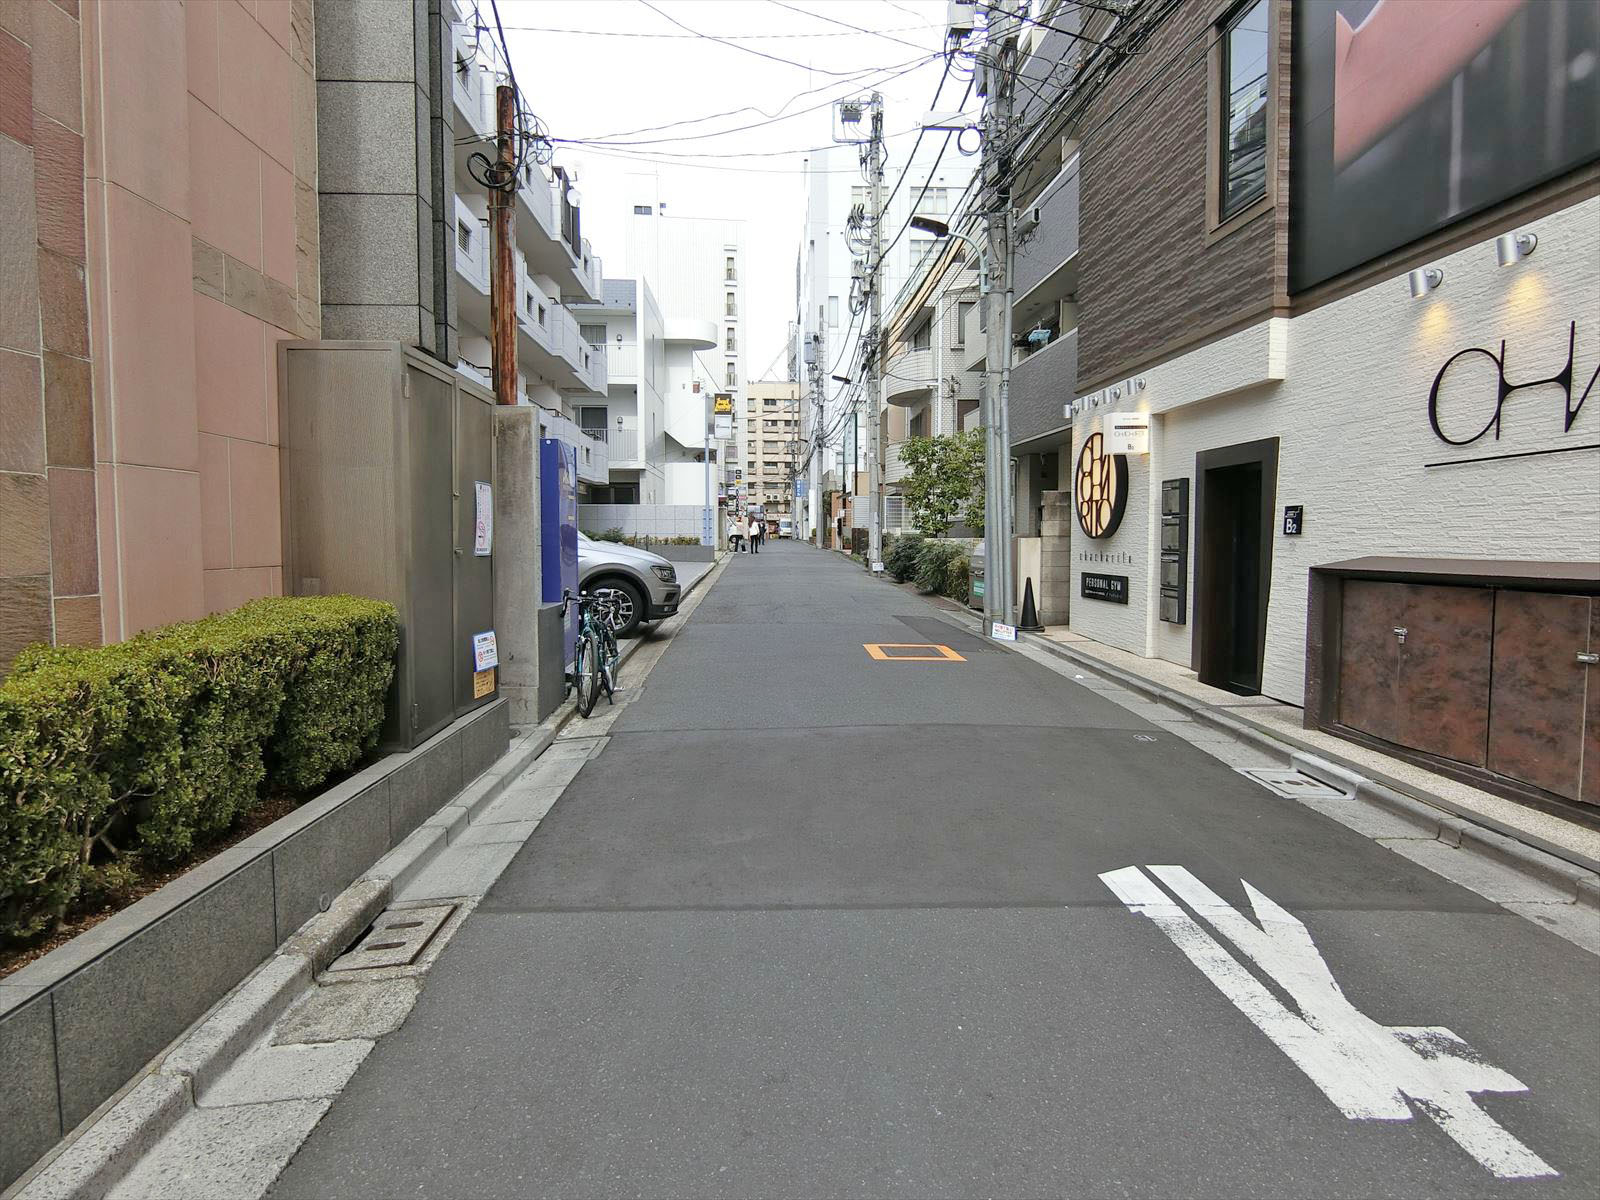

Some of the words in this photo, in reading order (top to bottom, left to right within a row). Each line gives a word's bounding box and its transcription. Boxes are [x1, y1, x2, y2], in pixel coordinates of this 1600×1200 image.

[1286, 519, 1296, 533] B2
[1085, 577, 1109, 589] PERSONAL
[1110, 580, 1121, 591] GYM
